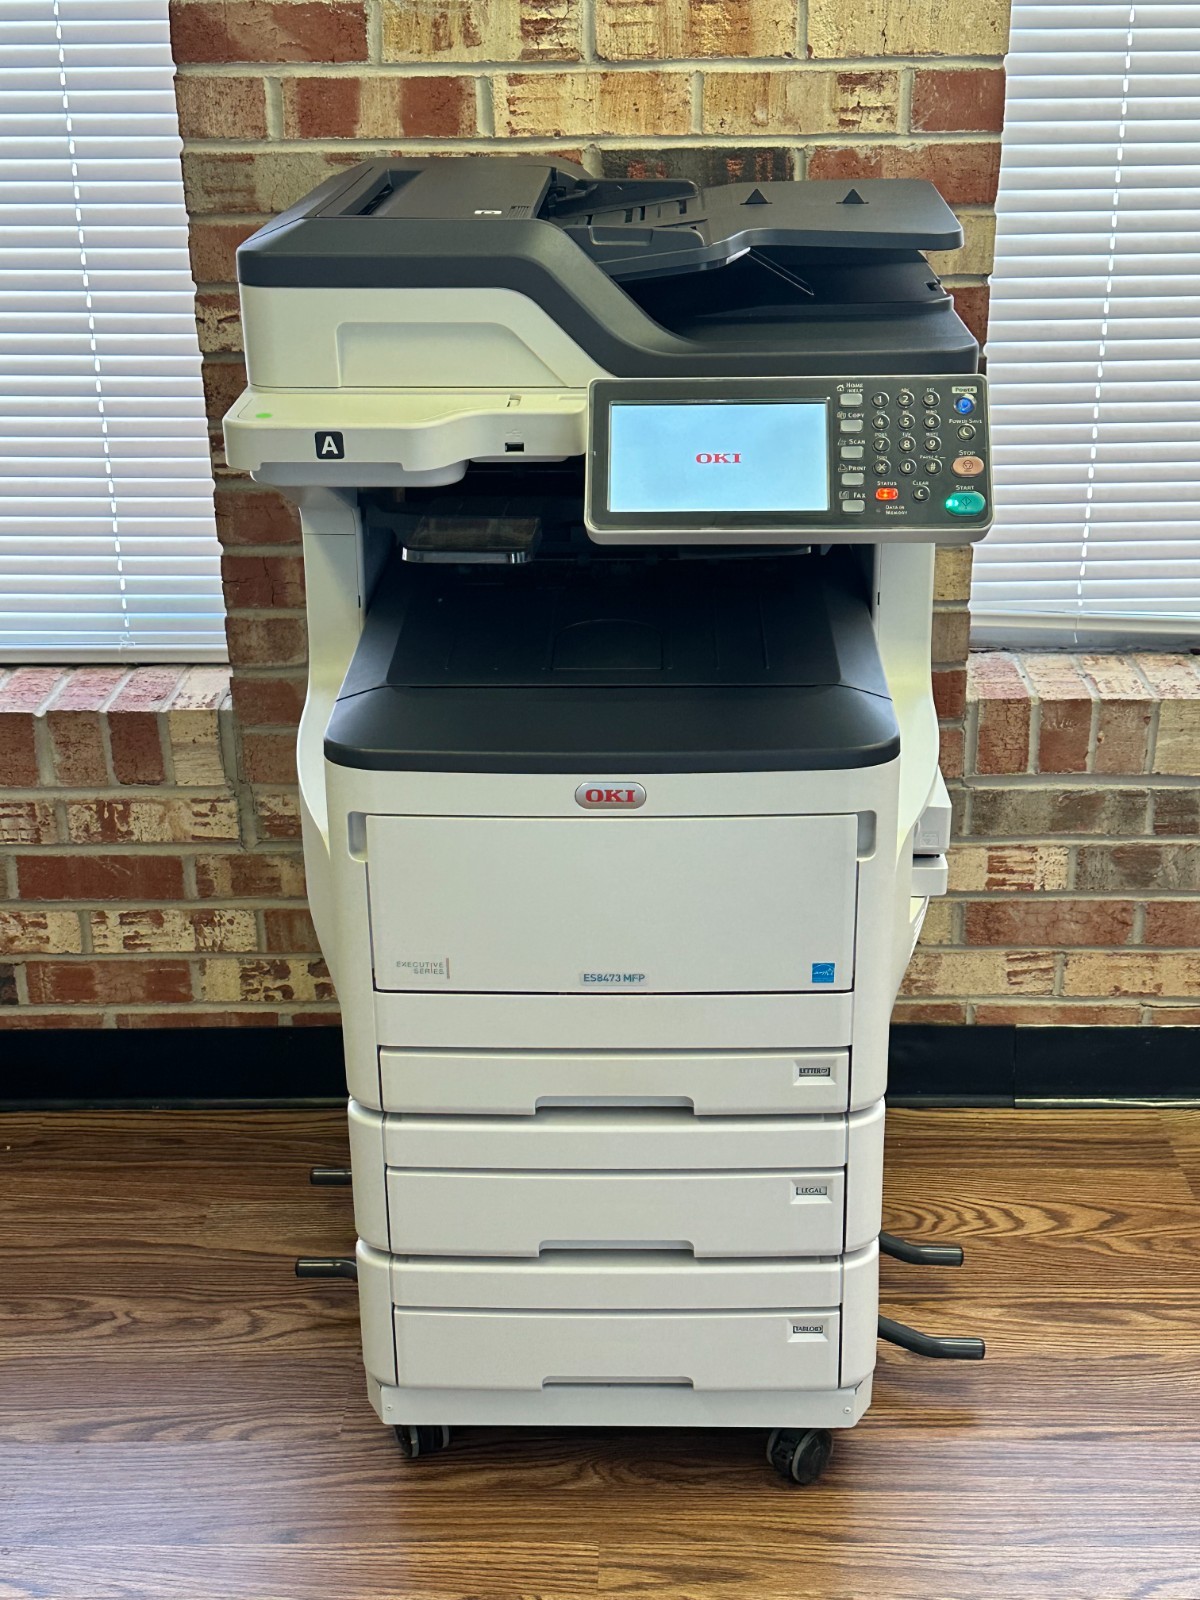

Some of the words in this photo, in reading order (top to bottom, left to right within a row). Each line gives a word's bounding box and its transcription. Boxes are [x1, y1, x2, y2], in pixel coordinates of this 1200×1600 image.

[878, 395, 882, 403] 1
[902, 395, 909, 403] 2
[928, 394, 934, 403] 3
[877, 417, 884, 426] 4
[903, 417, 910, 426] 5
[928, 416, 935, 425] 6
[321, 435, 339, 455] A
[878, 440, 885, 449] 7
[903, 440, 911, 448] 8
[929, 439, 936, 448] 9
[695, 453, 742, 464] OKI
[853, 491, 867, 499] FAX
[917, 489, 924, 497] C
[585, 788, 636, 803] OKI
[396, 960, 445, 968] EXECUTIVE
[413, 967, 445, 975] SERIES
[583, 973, 621, 982] ES8473
[623, 973, 646, 982] MFP
